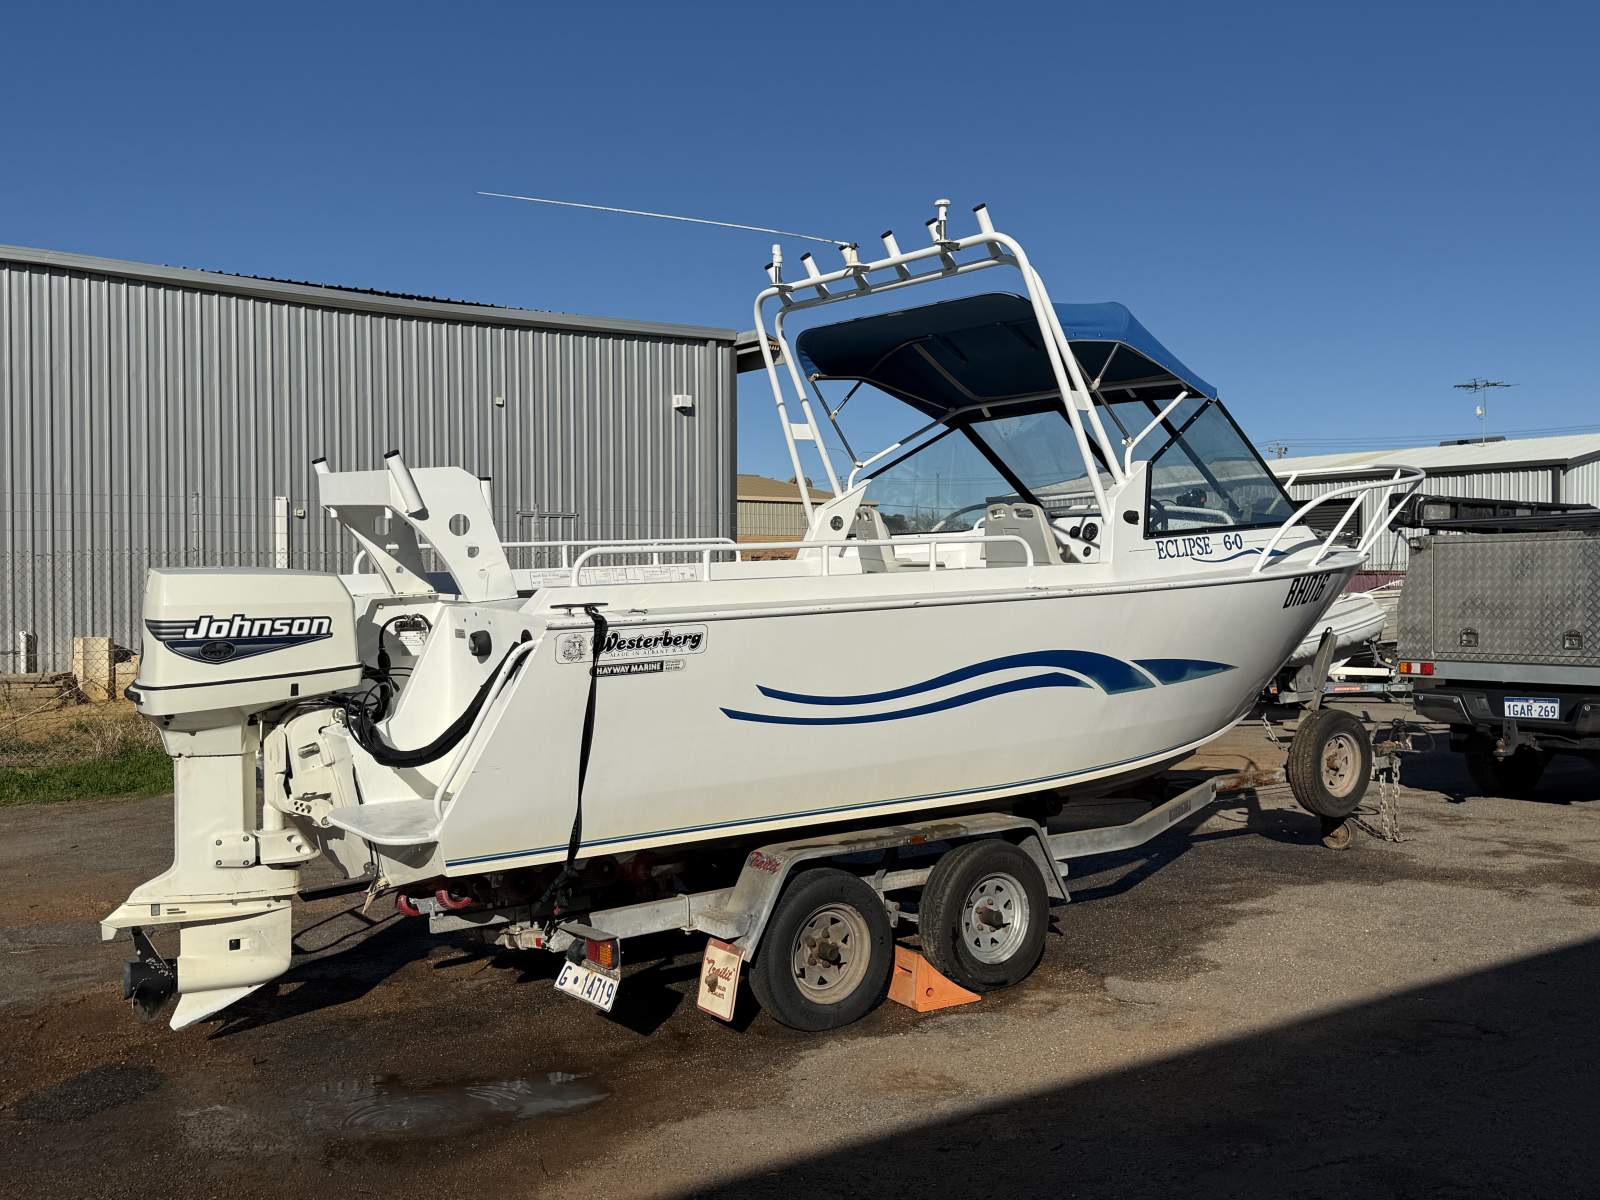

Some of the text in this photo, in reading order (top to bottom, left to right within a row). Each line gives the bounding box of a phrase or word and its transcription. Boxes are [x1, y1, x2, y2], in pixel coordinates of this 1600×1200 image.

[1155, 536, 1213, 560] ECLIPSE
[184, 614, 332, 640] Johnson
[600, 629, 703, 650] Westerberg
[596, 665, 630, 676] HAYWAY
[630, 662, 661, 672] MARINE
[580, 972, 615, 1006] 14719
